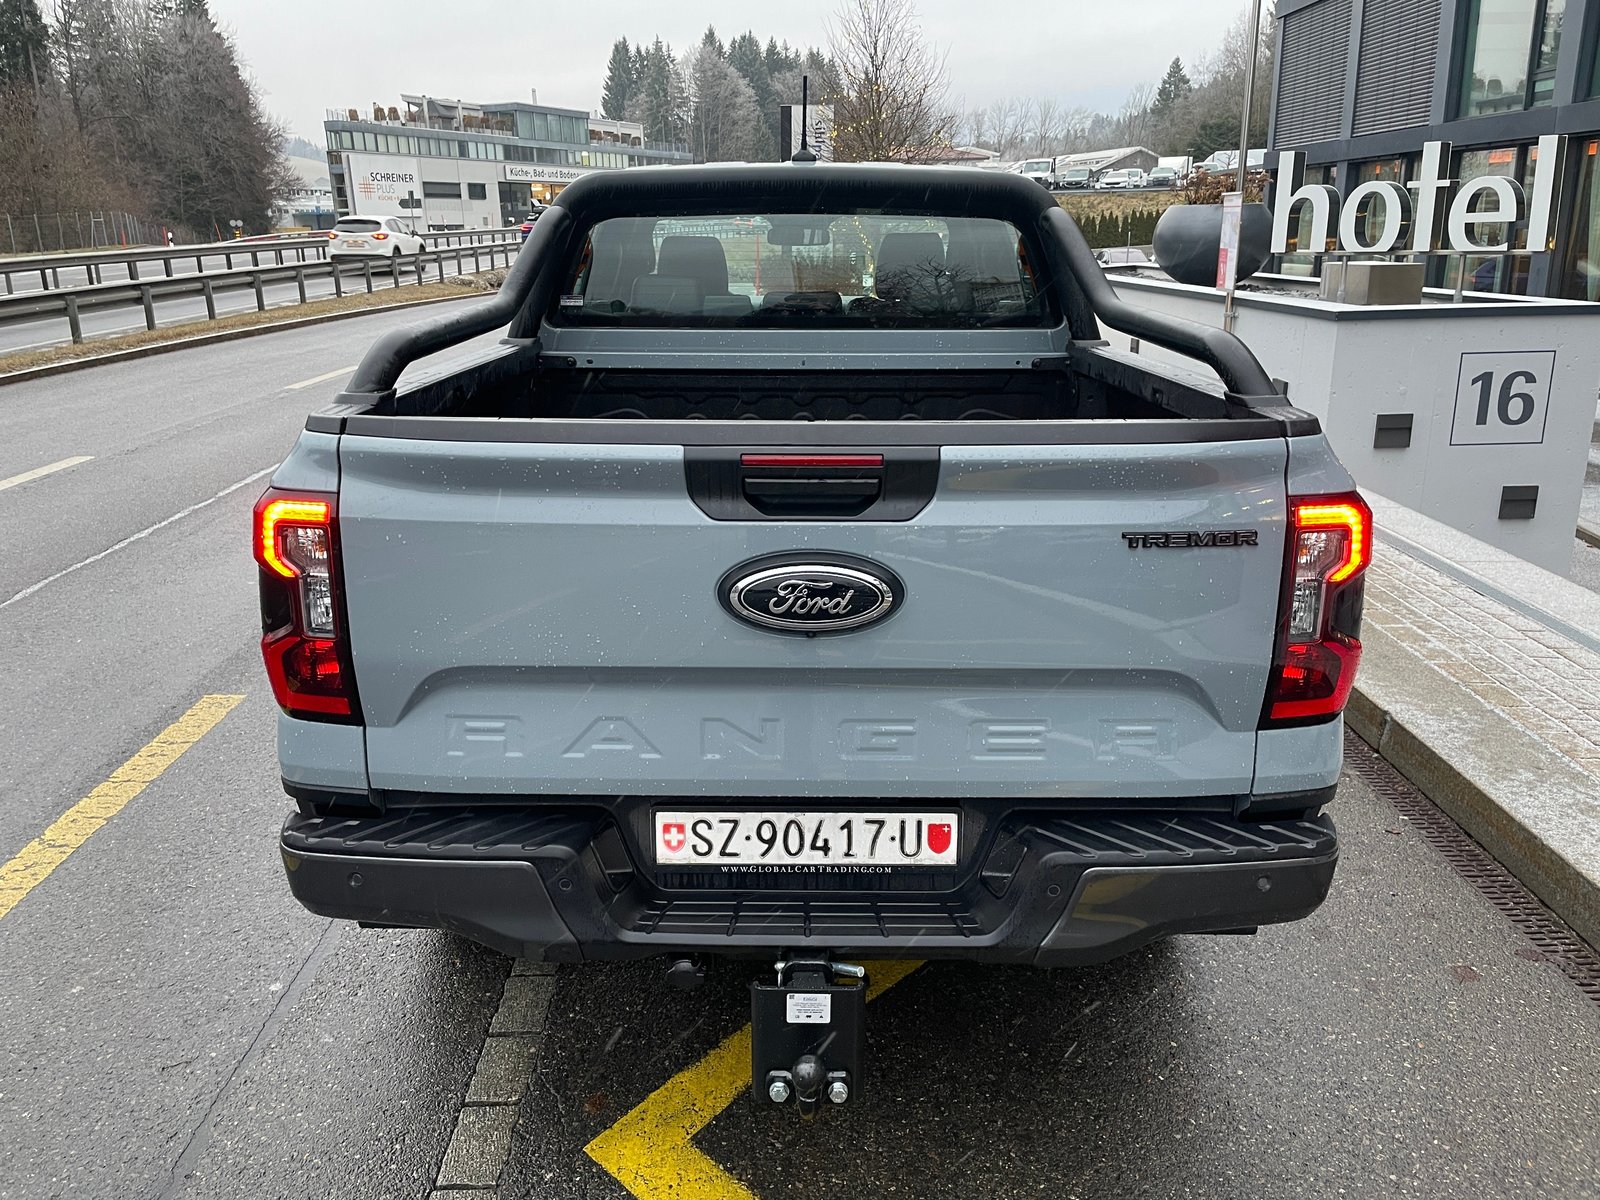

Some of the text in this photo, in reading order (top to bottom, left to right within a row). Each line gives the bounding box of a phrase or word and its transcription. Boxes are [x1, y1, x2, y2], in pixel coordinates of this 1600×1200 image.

[370, 172, 414, 183] SCHREINER
[547, 170, 559, 178] und
[376, 184, 395, 194] PLUS
[1270, 135, 1566, 253] hotel
[1470, 370, 1537, 426] 16
[1121, 529, 1259, 549] TREMOR
[768, 580, 855, 615] Ford
[445, 713, 1178, 761] RANGER
